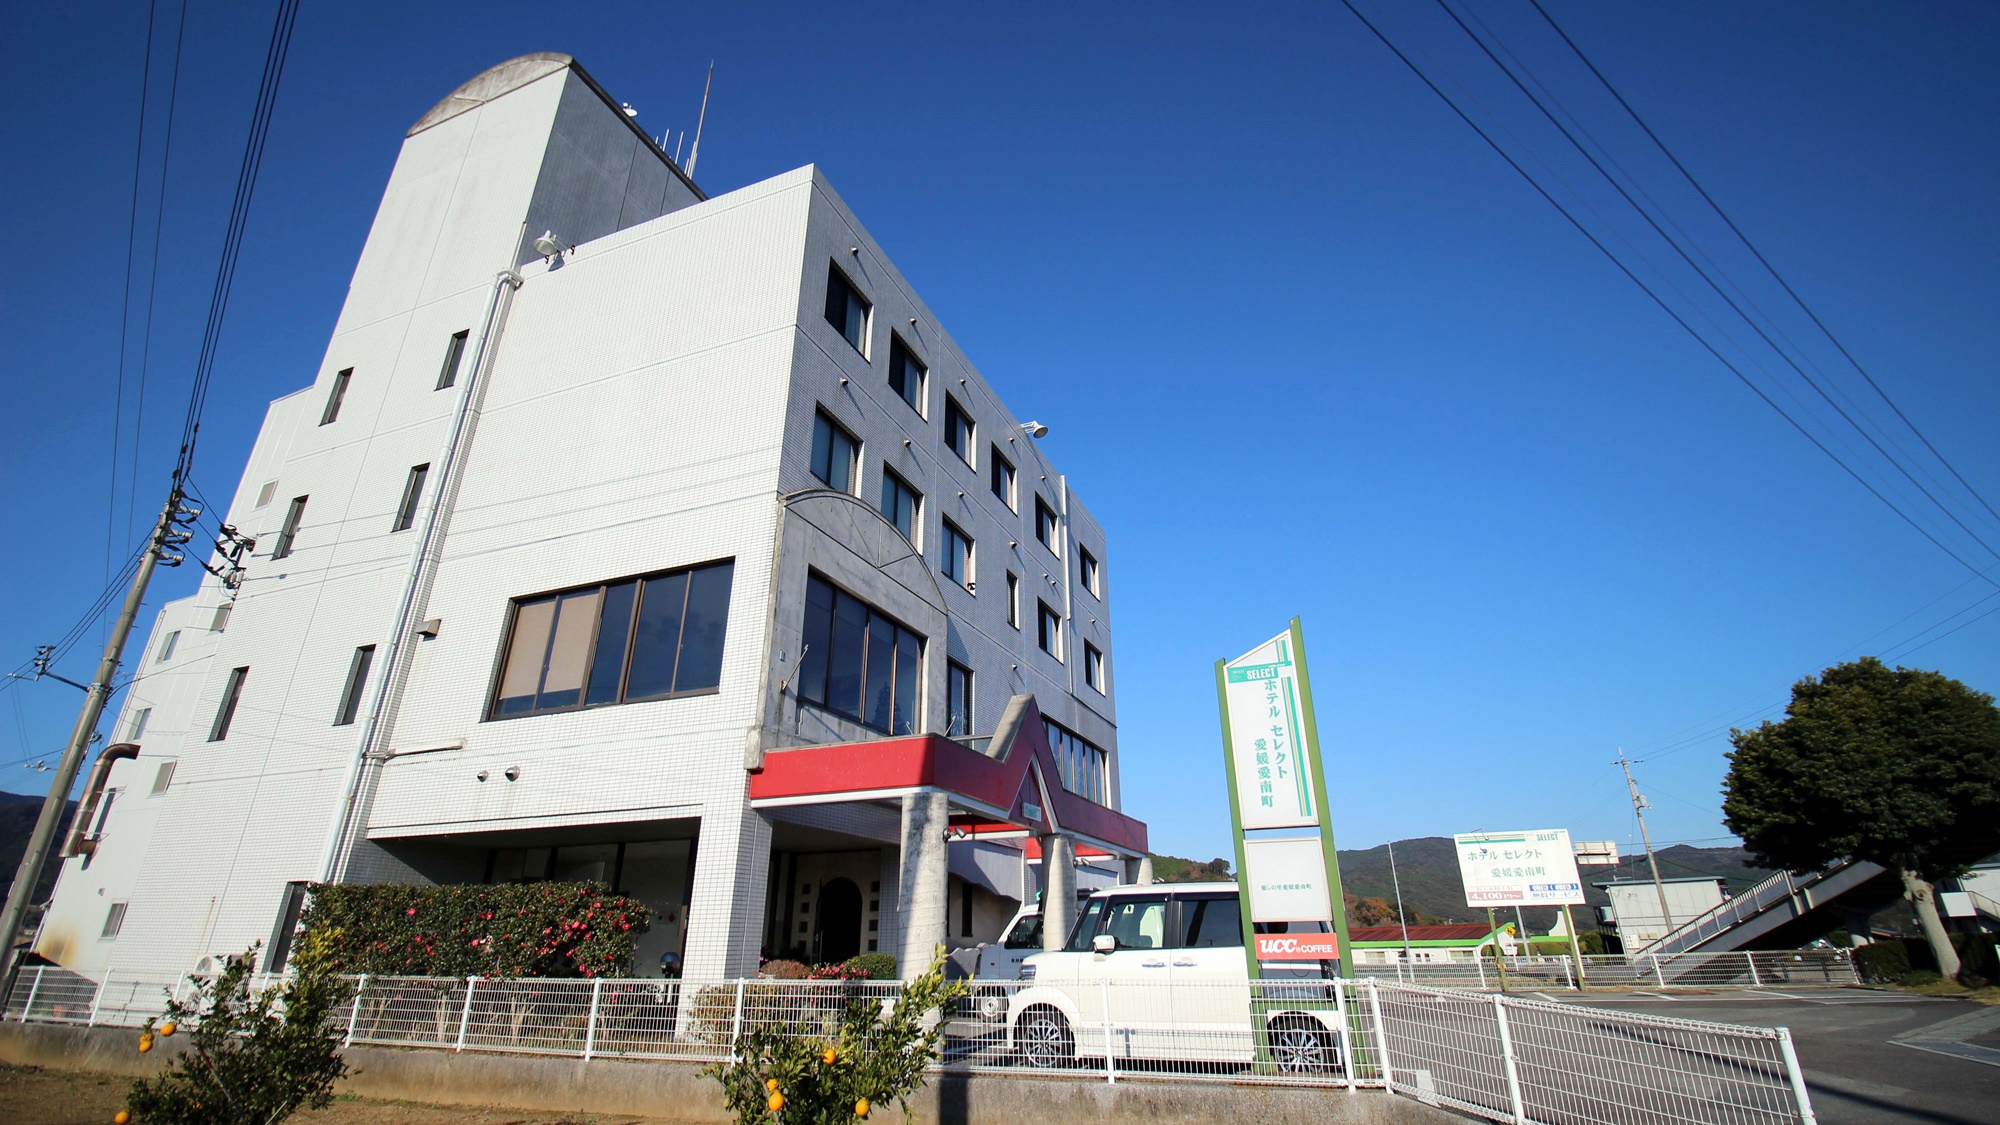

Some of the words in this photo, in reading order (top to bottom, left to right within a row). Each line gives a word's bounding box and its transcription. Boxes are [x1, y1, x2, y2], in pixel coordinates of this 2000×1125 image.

[1246, 667, 1275, 680] SELECT
[1264, 680, 1281, 718] ホテル
[1270, 725, 1287, 779] セレクト
[1254, 738, 1274, 808] 愛媛愛南町
[1536, 833, 1559, 842] SELECT
[1467, 850, 1498, 862] ホテル
[1502, 848, 1543, 860] セレクト
[1490, 866, 1546, 878] 愛媛愛南町
[1301, 944, 1333, 953] COFFEE
